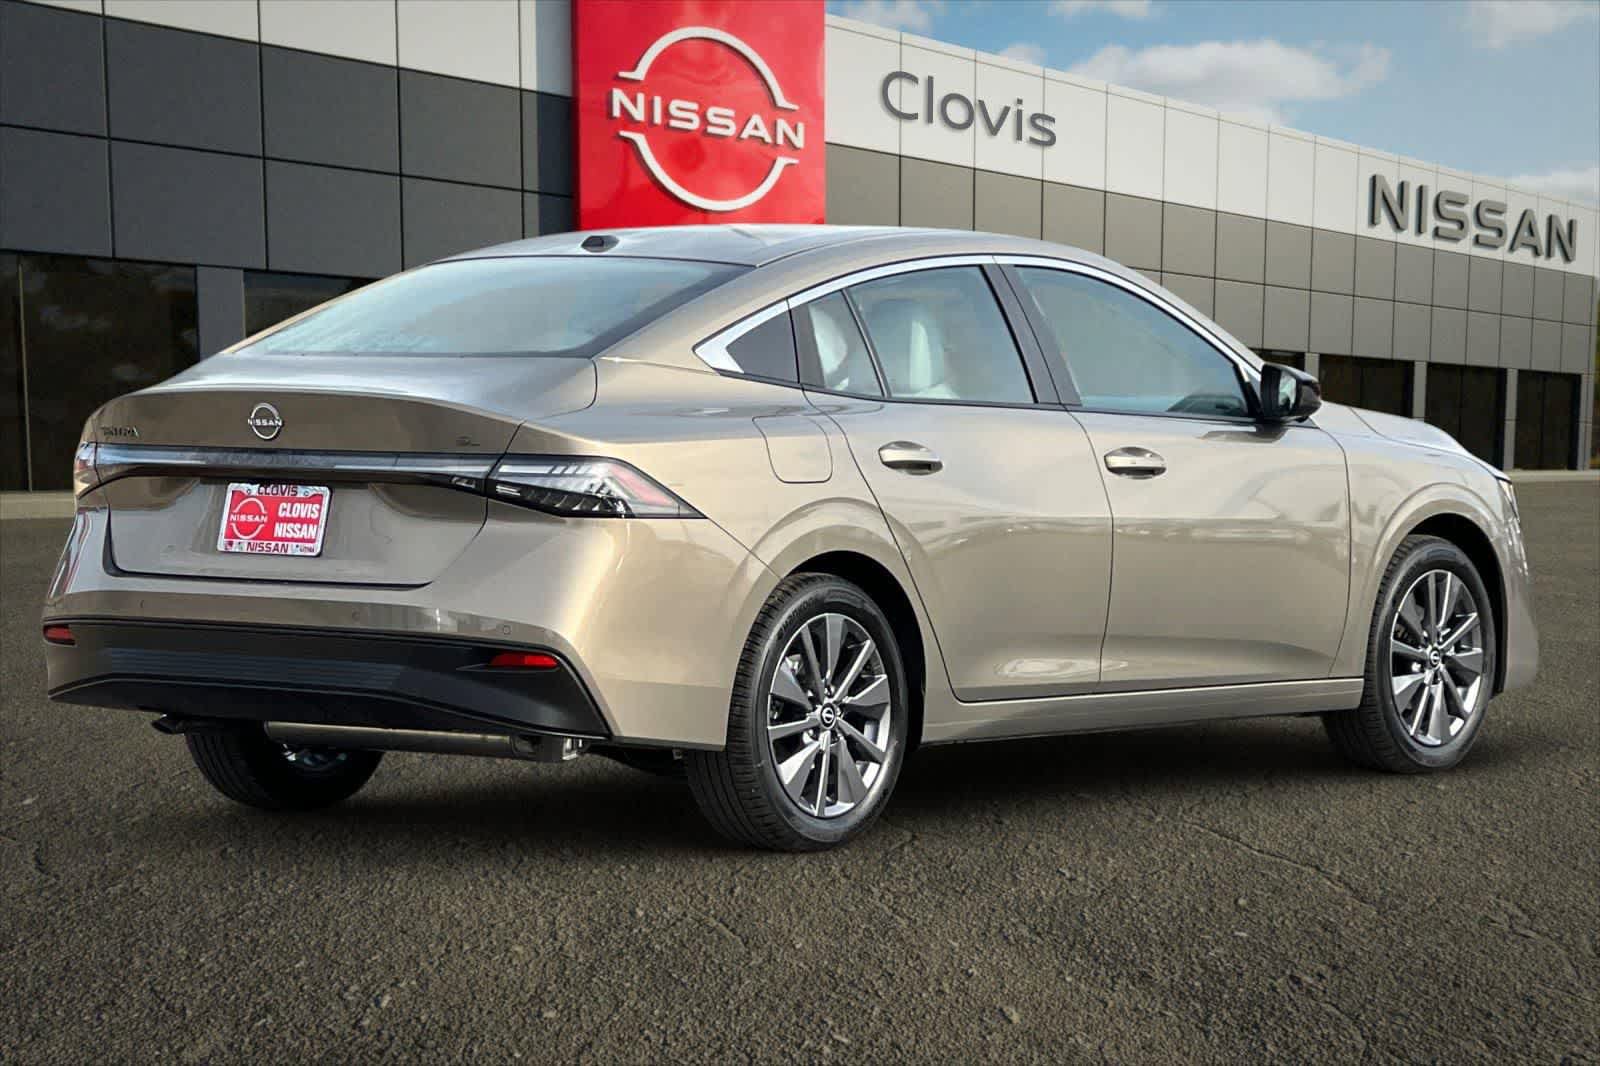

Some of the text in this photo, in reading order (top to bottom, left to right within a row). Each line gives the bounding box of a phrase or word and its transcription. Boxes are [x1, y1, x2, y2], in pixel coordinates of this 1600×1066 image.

[881, 70, 1057, 147] Clovis
[611, 88, 805, 148] NISSAN
[1369, 174, 1577, 263] NISSAN
[247, 418, 282, 427] NISSAN
[257, 484, 298, 497] CLOVIS
[230, 513, 268, 523] NISSAN
[278, 502, 319, 519] CLOVIS
[273, 521, 317, 539] NISSAN
[246, 541, 289, 553] NISSAN
